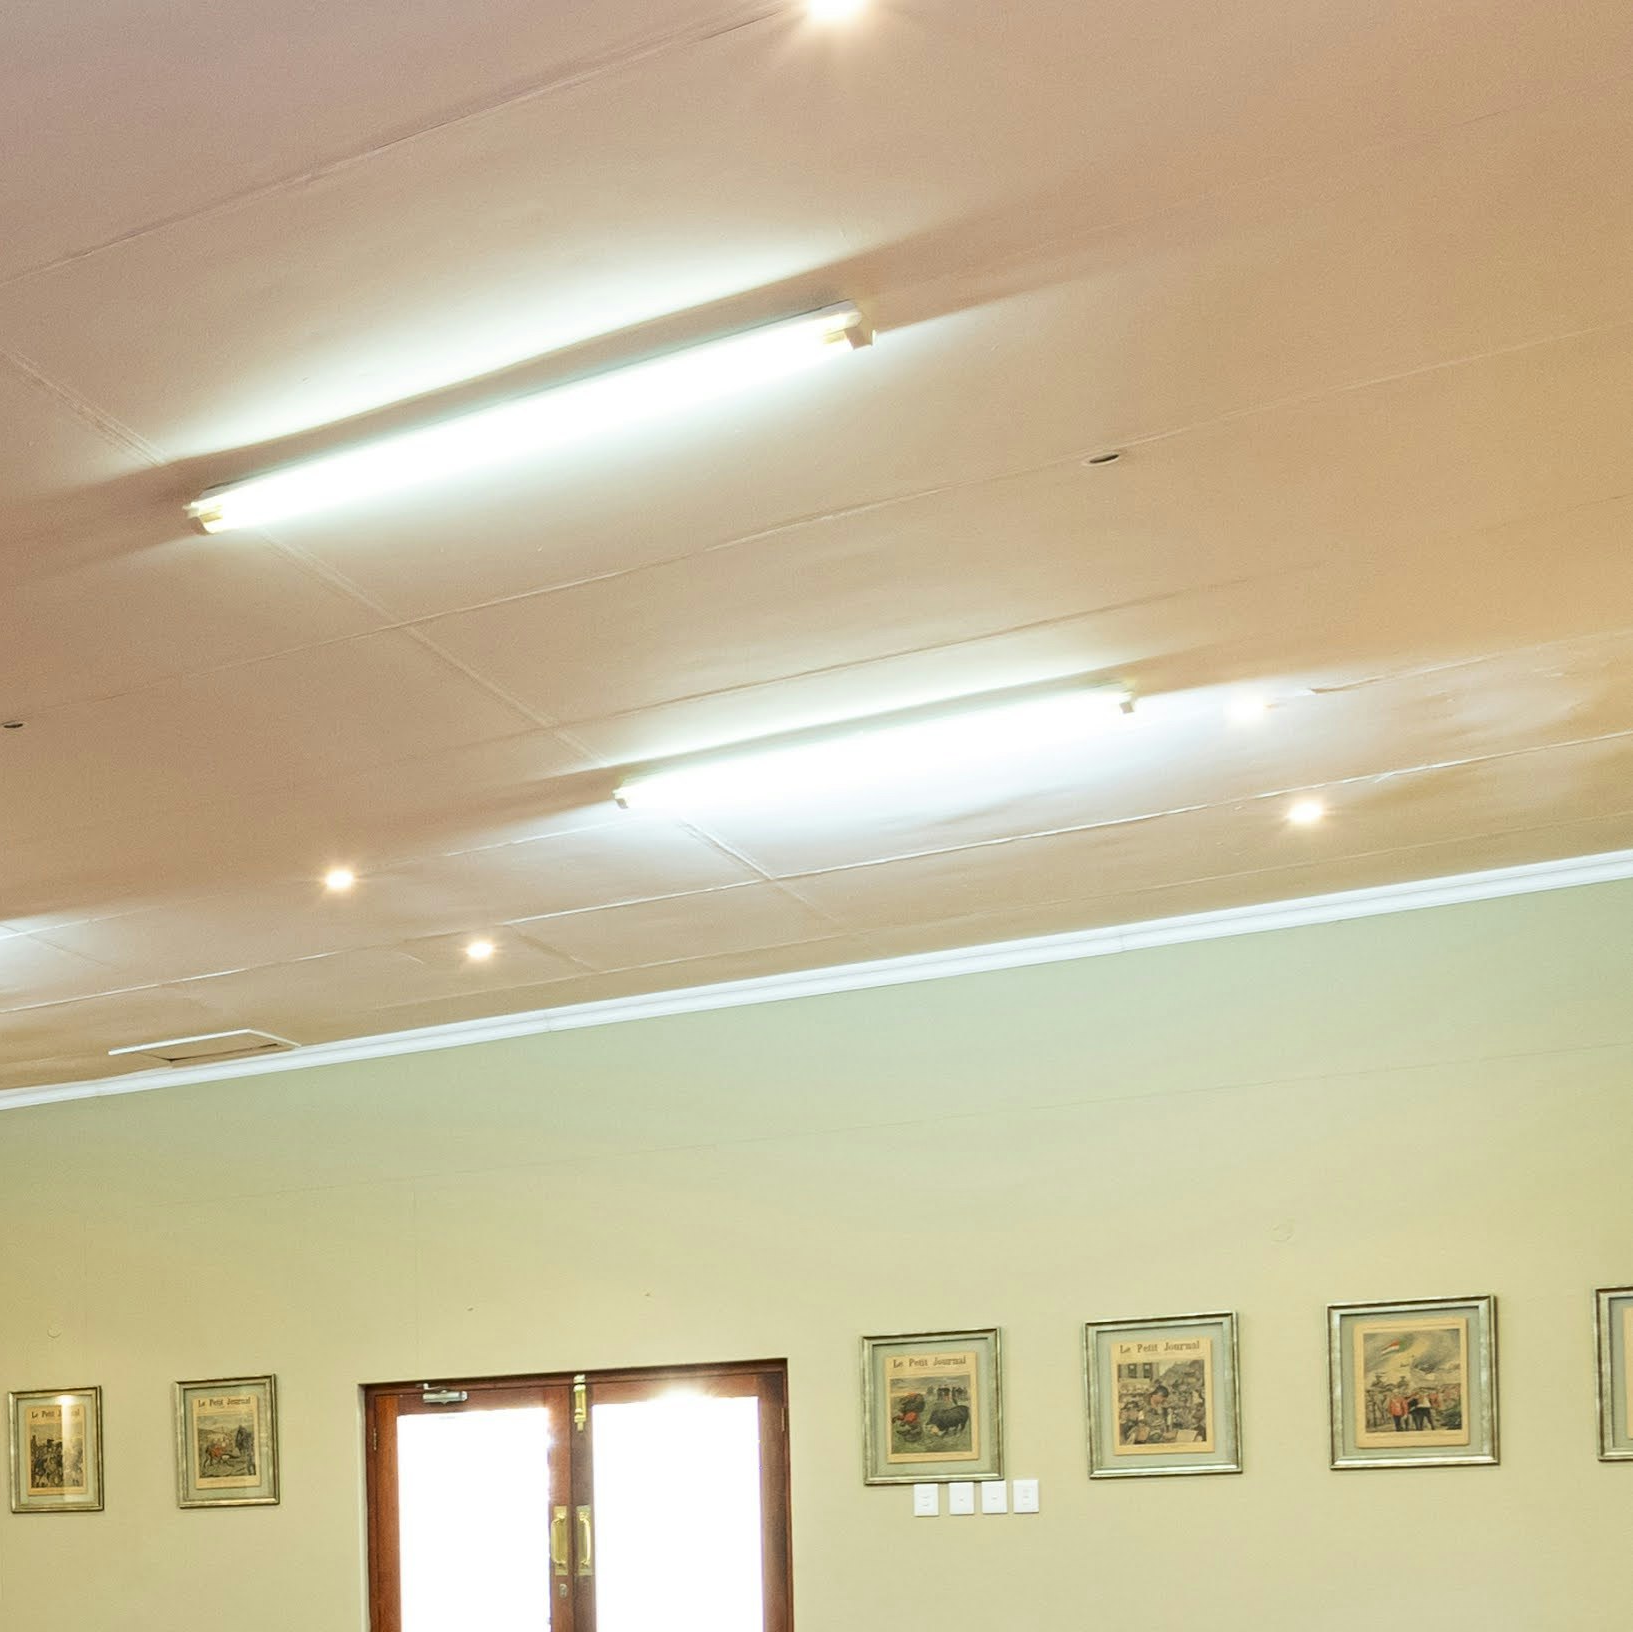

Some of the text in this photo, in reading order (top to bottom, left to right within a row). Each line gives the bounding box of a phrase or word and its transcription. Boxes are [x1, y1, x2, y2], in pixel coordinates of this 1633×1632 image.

[1119, 1340, 1200, 1354] Le Petit Journal
[893, 1359, 904, 1369] Le
